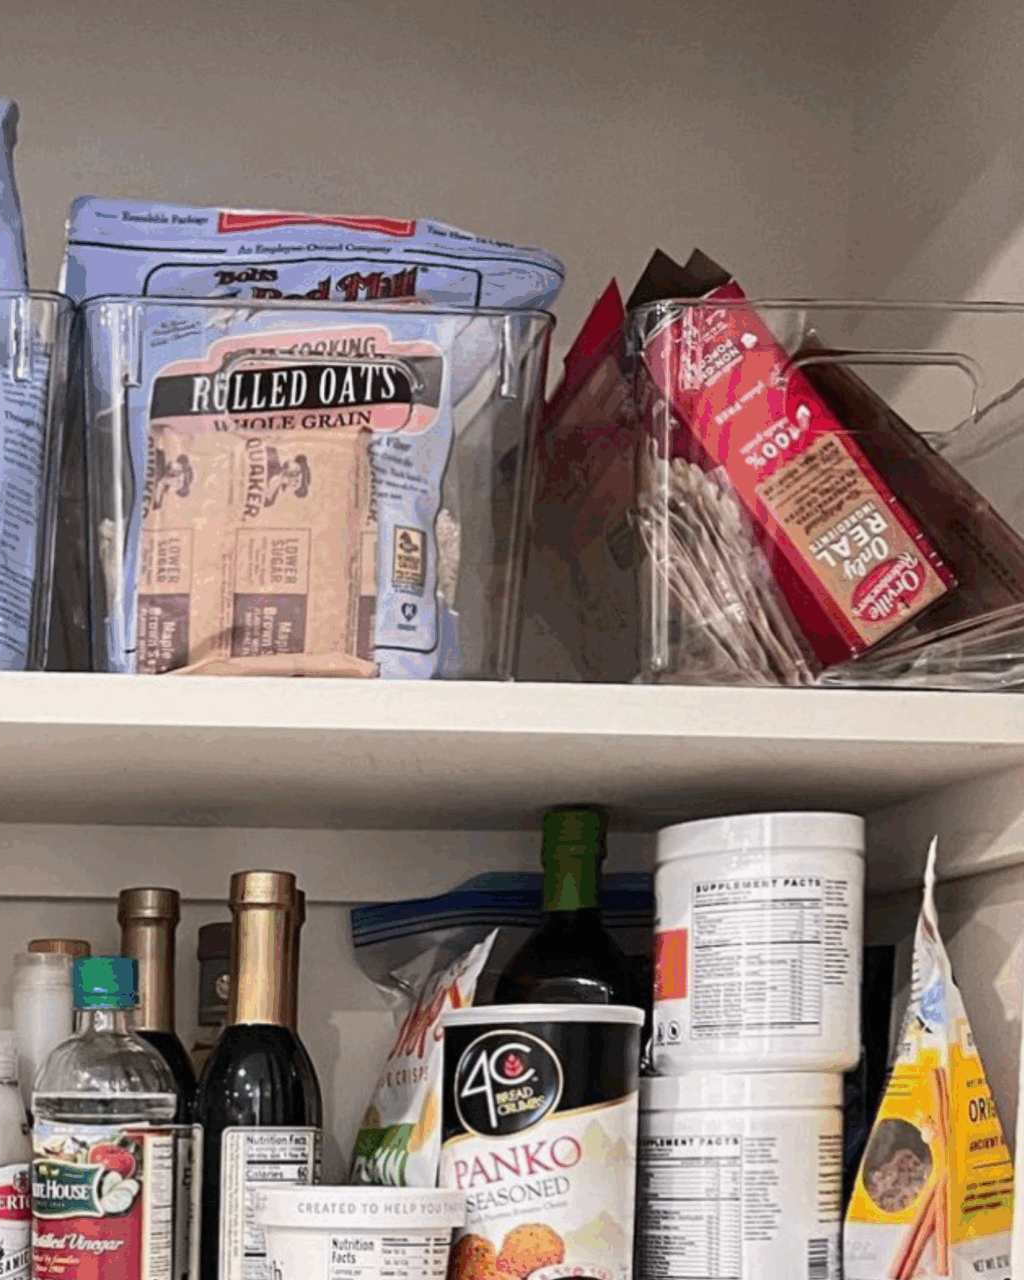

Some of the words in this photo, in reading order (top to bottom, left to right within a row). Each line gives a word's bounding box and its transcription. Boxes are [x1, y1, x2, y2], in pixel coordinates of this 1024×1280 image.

[344, 243, 393, 256] Company
[190, 372, 309, 413] ROLLED
[318, 365, 397, 405] OATS
[213, 415, 295, 433] WHOLE
[299, 410, 373, 431] GRAIN
[242, 437, 262, 520] QUAKER
[808, 501, 876, 553] INGREDIENTS
[816, 513, 888, 569] REAL
[269, 539, 283, 582] SUGAR
[283, 537, 298, 585] LOWER
[842, 537, 888, 580] Only
[872, 568, 921, 621] Orville
[695, 879, 779, 895] SUPPLEMENT
[783, 878, 822, 888] FACTS
[495, 1087, 534, 1104] BREAD
[246, 1135, 288, 1146] Nutrition
[698, 1136, 740, 1147] FACTS
[453, 1135, 582, 1191] PANKO
[297, 1203, 357, 1214] CREATED
[362, 1202, 380, 1214] TO
[384, 1201, 418, 1214] HELP
[420, 1201, 442, 1214] YOU
[466, 1175, 571, 1215] SEASONED
[68, 1233, 125, 1255] Vinegar
[332, 1238, 375, 1252] Nutrition
[332, 1251, 356, 1265] Facts
